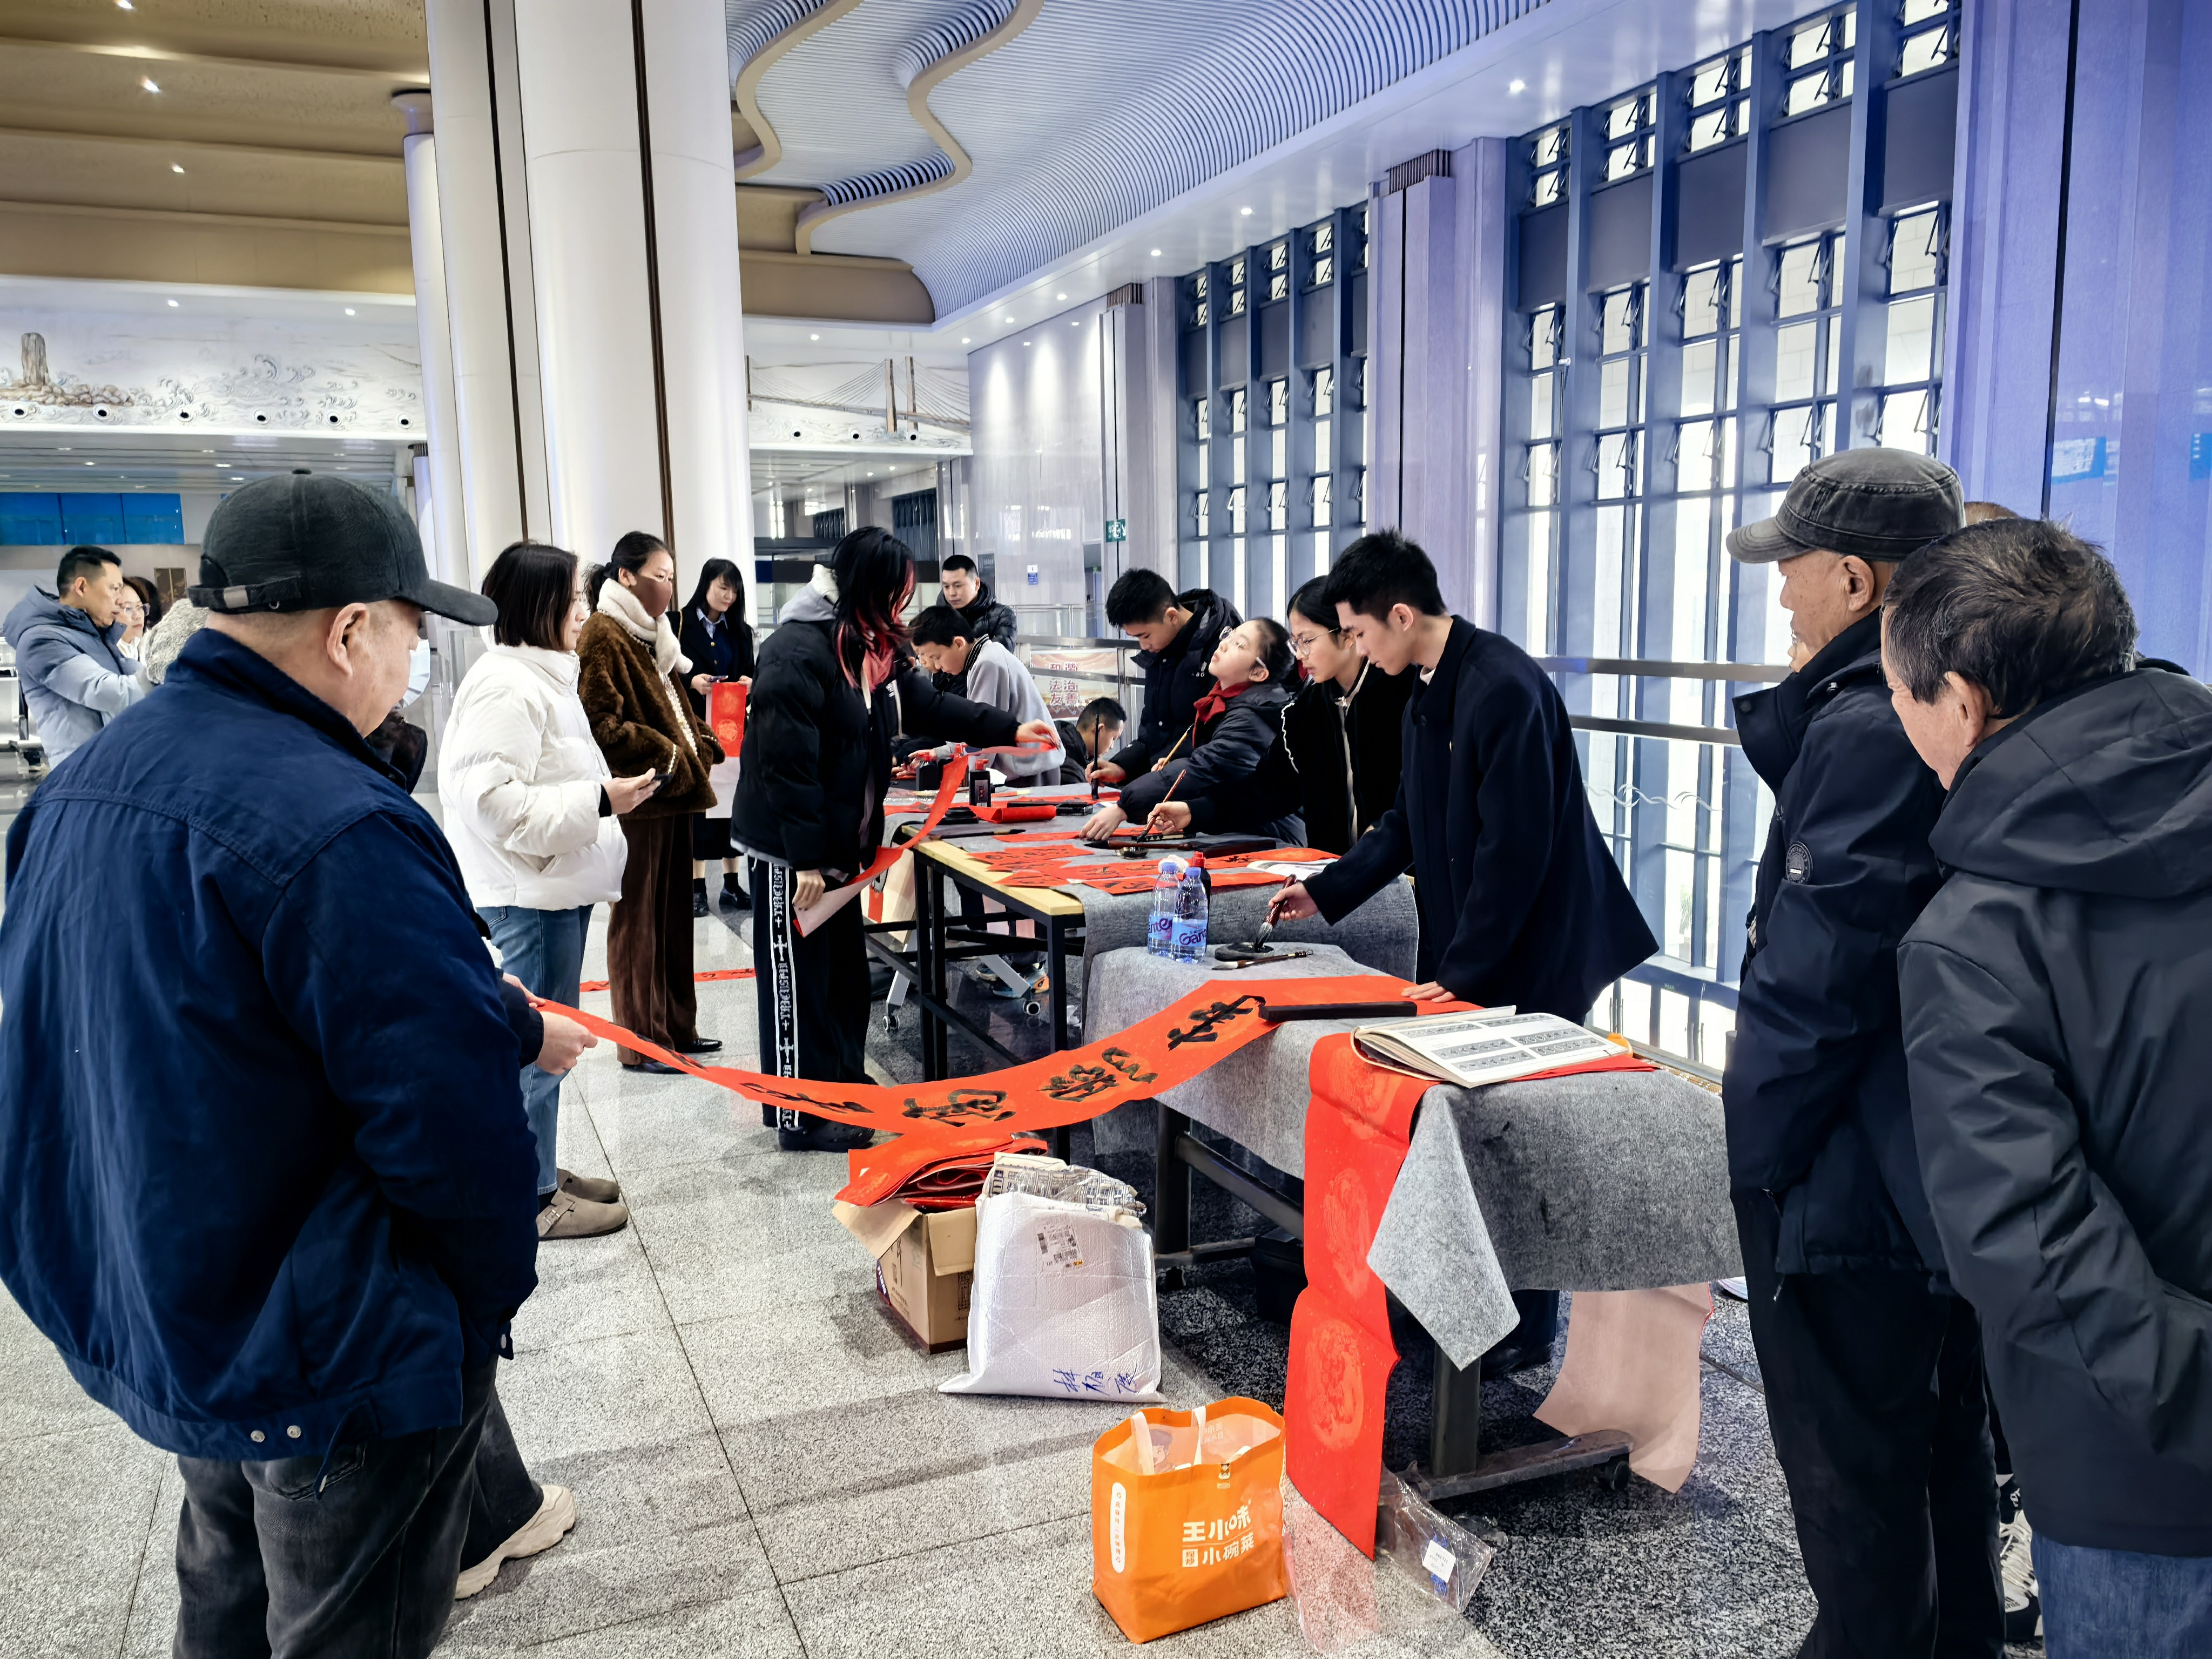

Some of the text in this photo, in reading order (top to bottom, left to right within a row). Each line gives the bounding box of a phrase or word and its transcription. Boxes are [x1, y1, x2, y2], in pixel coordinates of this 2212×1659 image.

[1049, 680, 1078, 692] 法治
[1050, 693, 1078, 705] 友善
[1182, 1500, 1251, 1542] 王小味
[1202, 1532, 1255, 1565] 小碗菜
